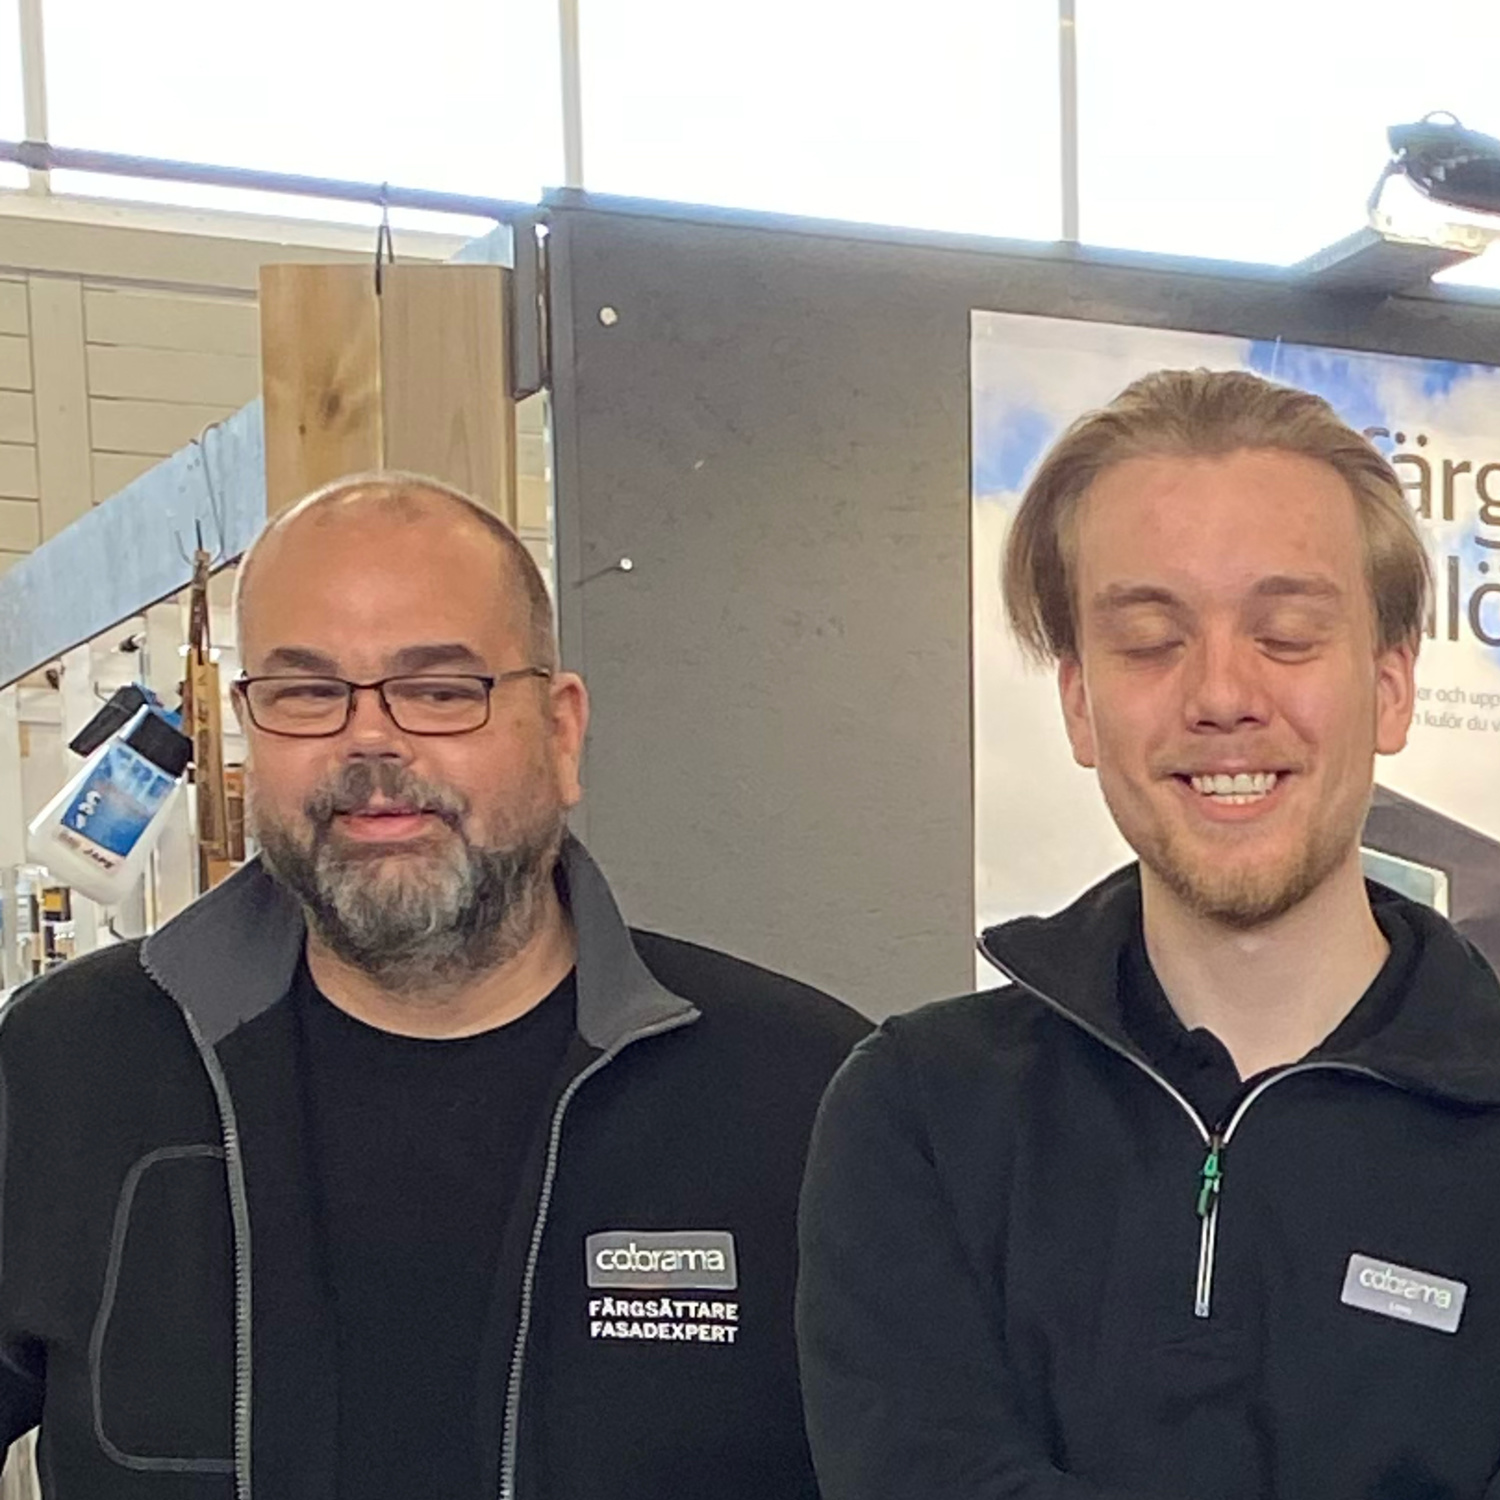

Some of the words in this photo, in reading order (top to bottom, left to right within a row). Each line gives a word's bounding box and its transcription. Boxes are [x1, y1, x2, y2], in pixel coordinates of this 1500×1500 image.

[1436, 687, 1466, 704] och
[1424, 710, 1463, 729] kulör
[1467, 715, 1488, 731] du
[596, 1242, 726, 1272] colorama
[588, 1297, 739, 1320] FÄRGSÄTTARE
[590, 1321, 739, 1342] FASADEXPERT
